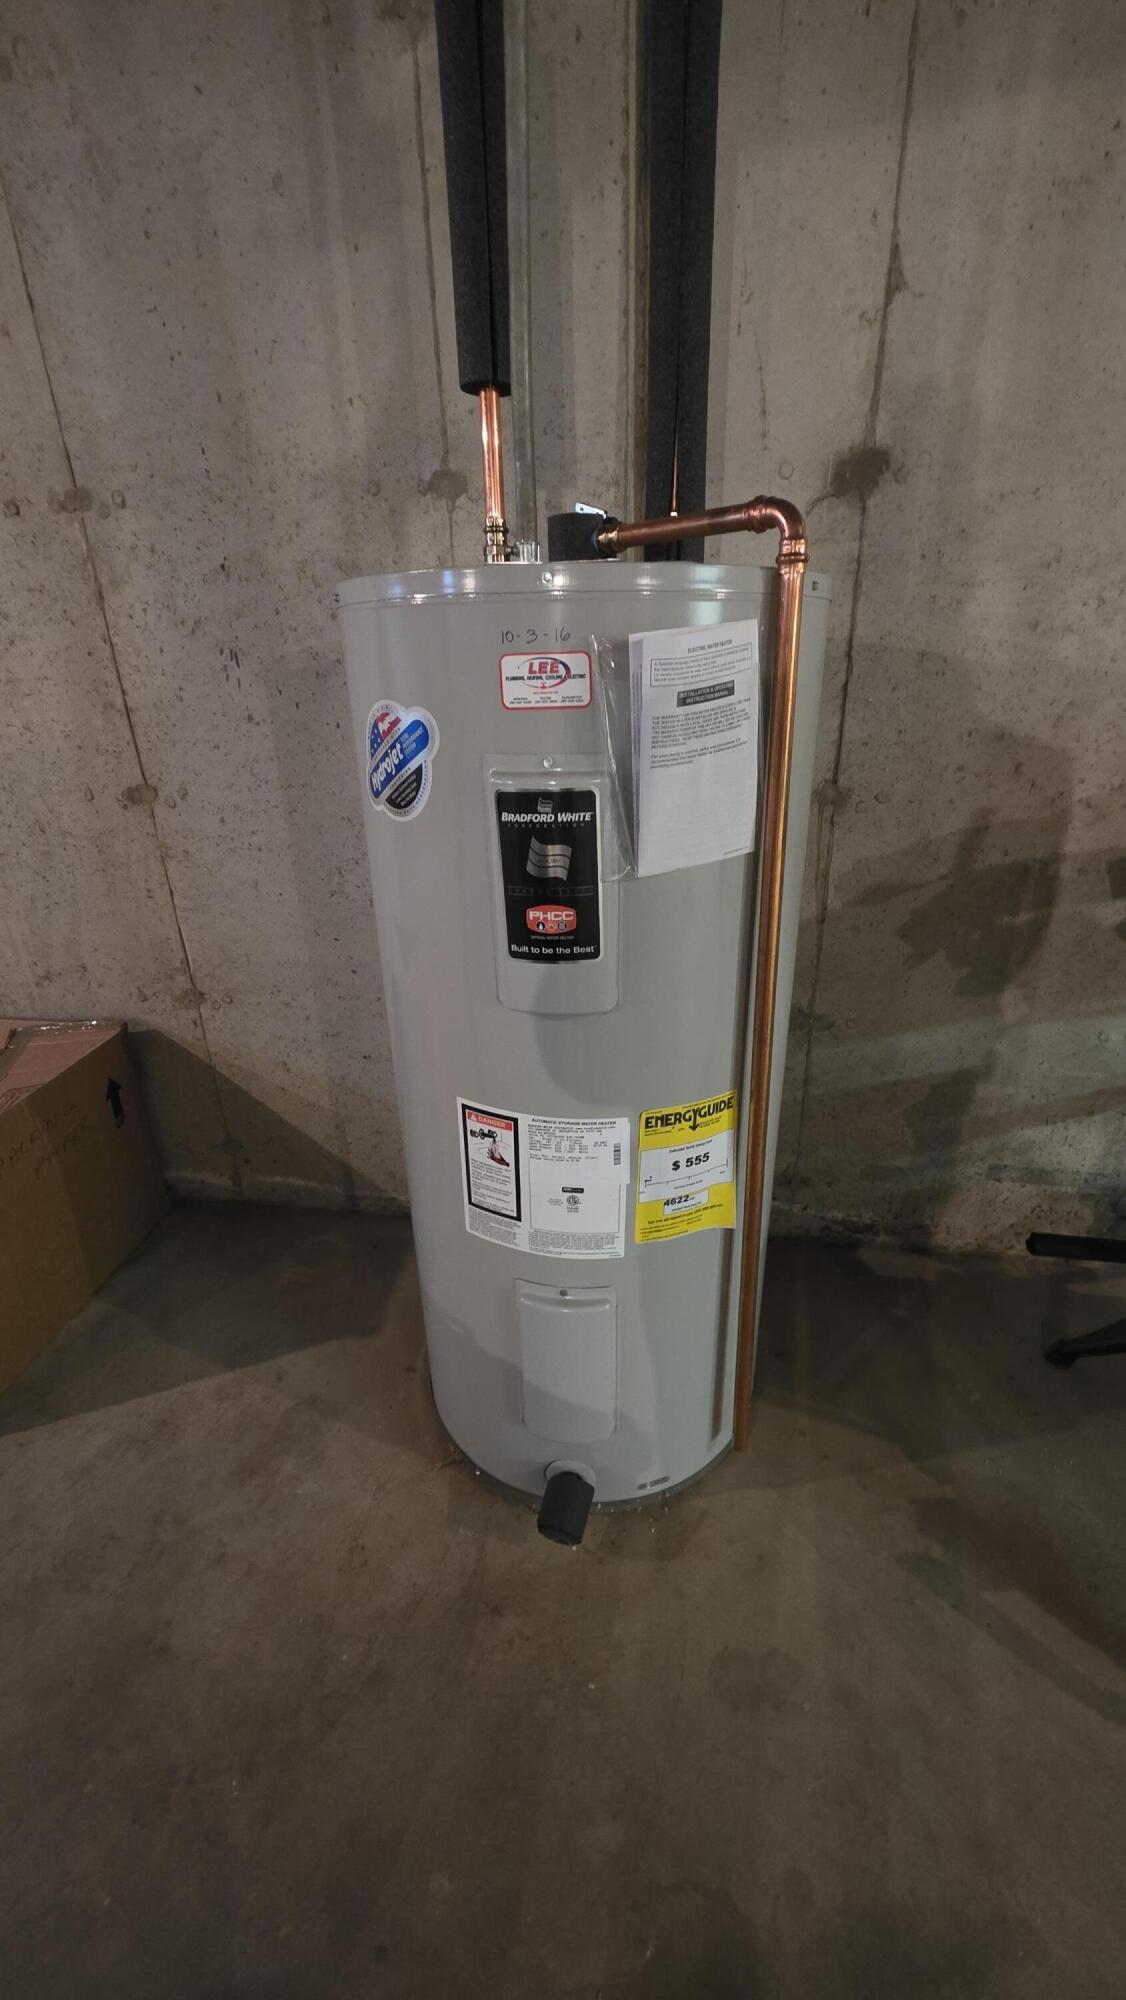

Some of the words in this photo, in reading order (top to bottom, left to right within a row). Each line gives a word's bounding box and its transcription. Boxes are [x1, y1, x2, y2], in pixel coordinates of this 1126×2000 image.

[528, 661, 561, 675] LEE
[371, 741, 404, 792] Hydrojet
[501, 812, 555, 823] BRADFORD
[557, 811, 592, 823] WHITE
[528, 911, 575, 921] PHCC
[511, 944, 529, 953] Built
[531, 945, 540, 954] to
[542, 946, 553, 954] be
[556, 946, 571, 954] the
[573, 945, 595, 953] Best
[644, 1096, 735, 1130] ENERGYGUIDE
[478, 1115, 506, 1129] DANGER
[671, 1160, 681, 1171] $
[685, 1152, 710, 1168] 555
[663, 1194, 690, 1207] 4622
